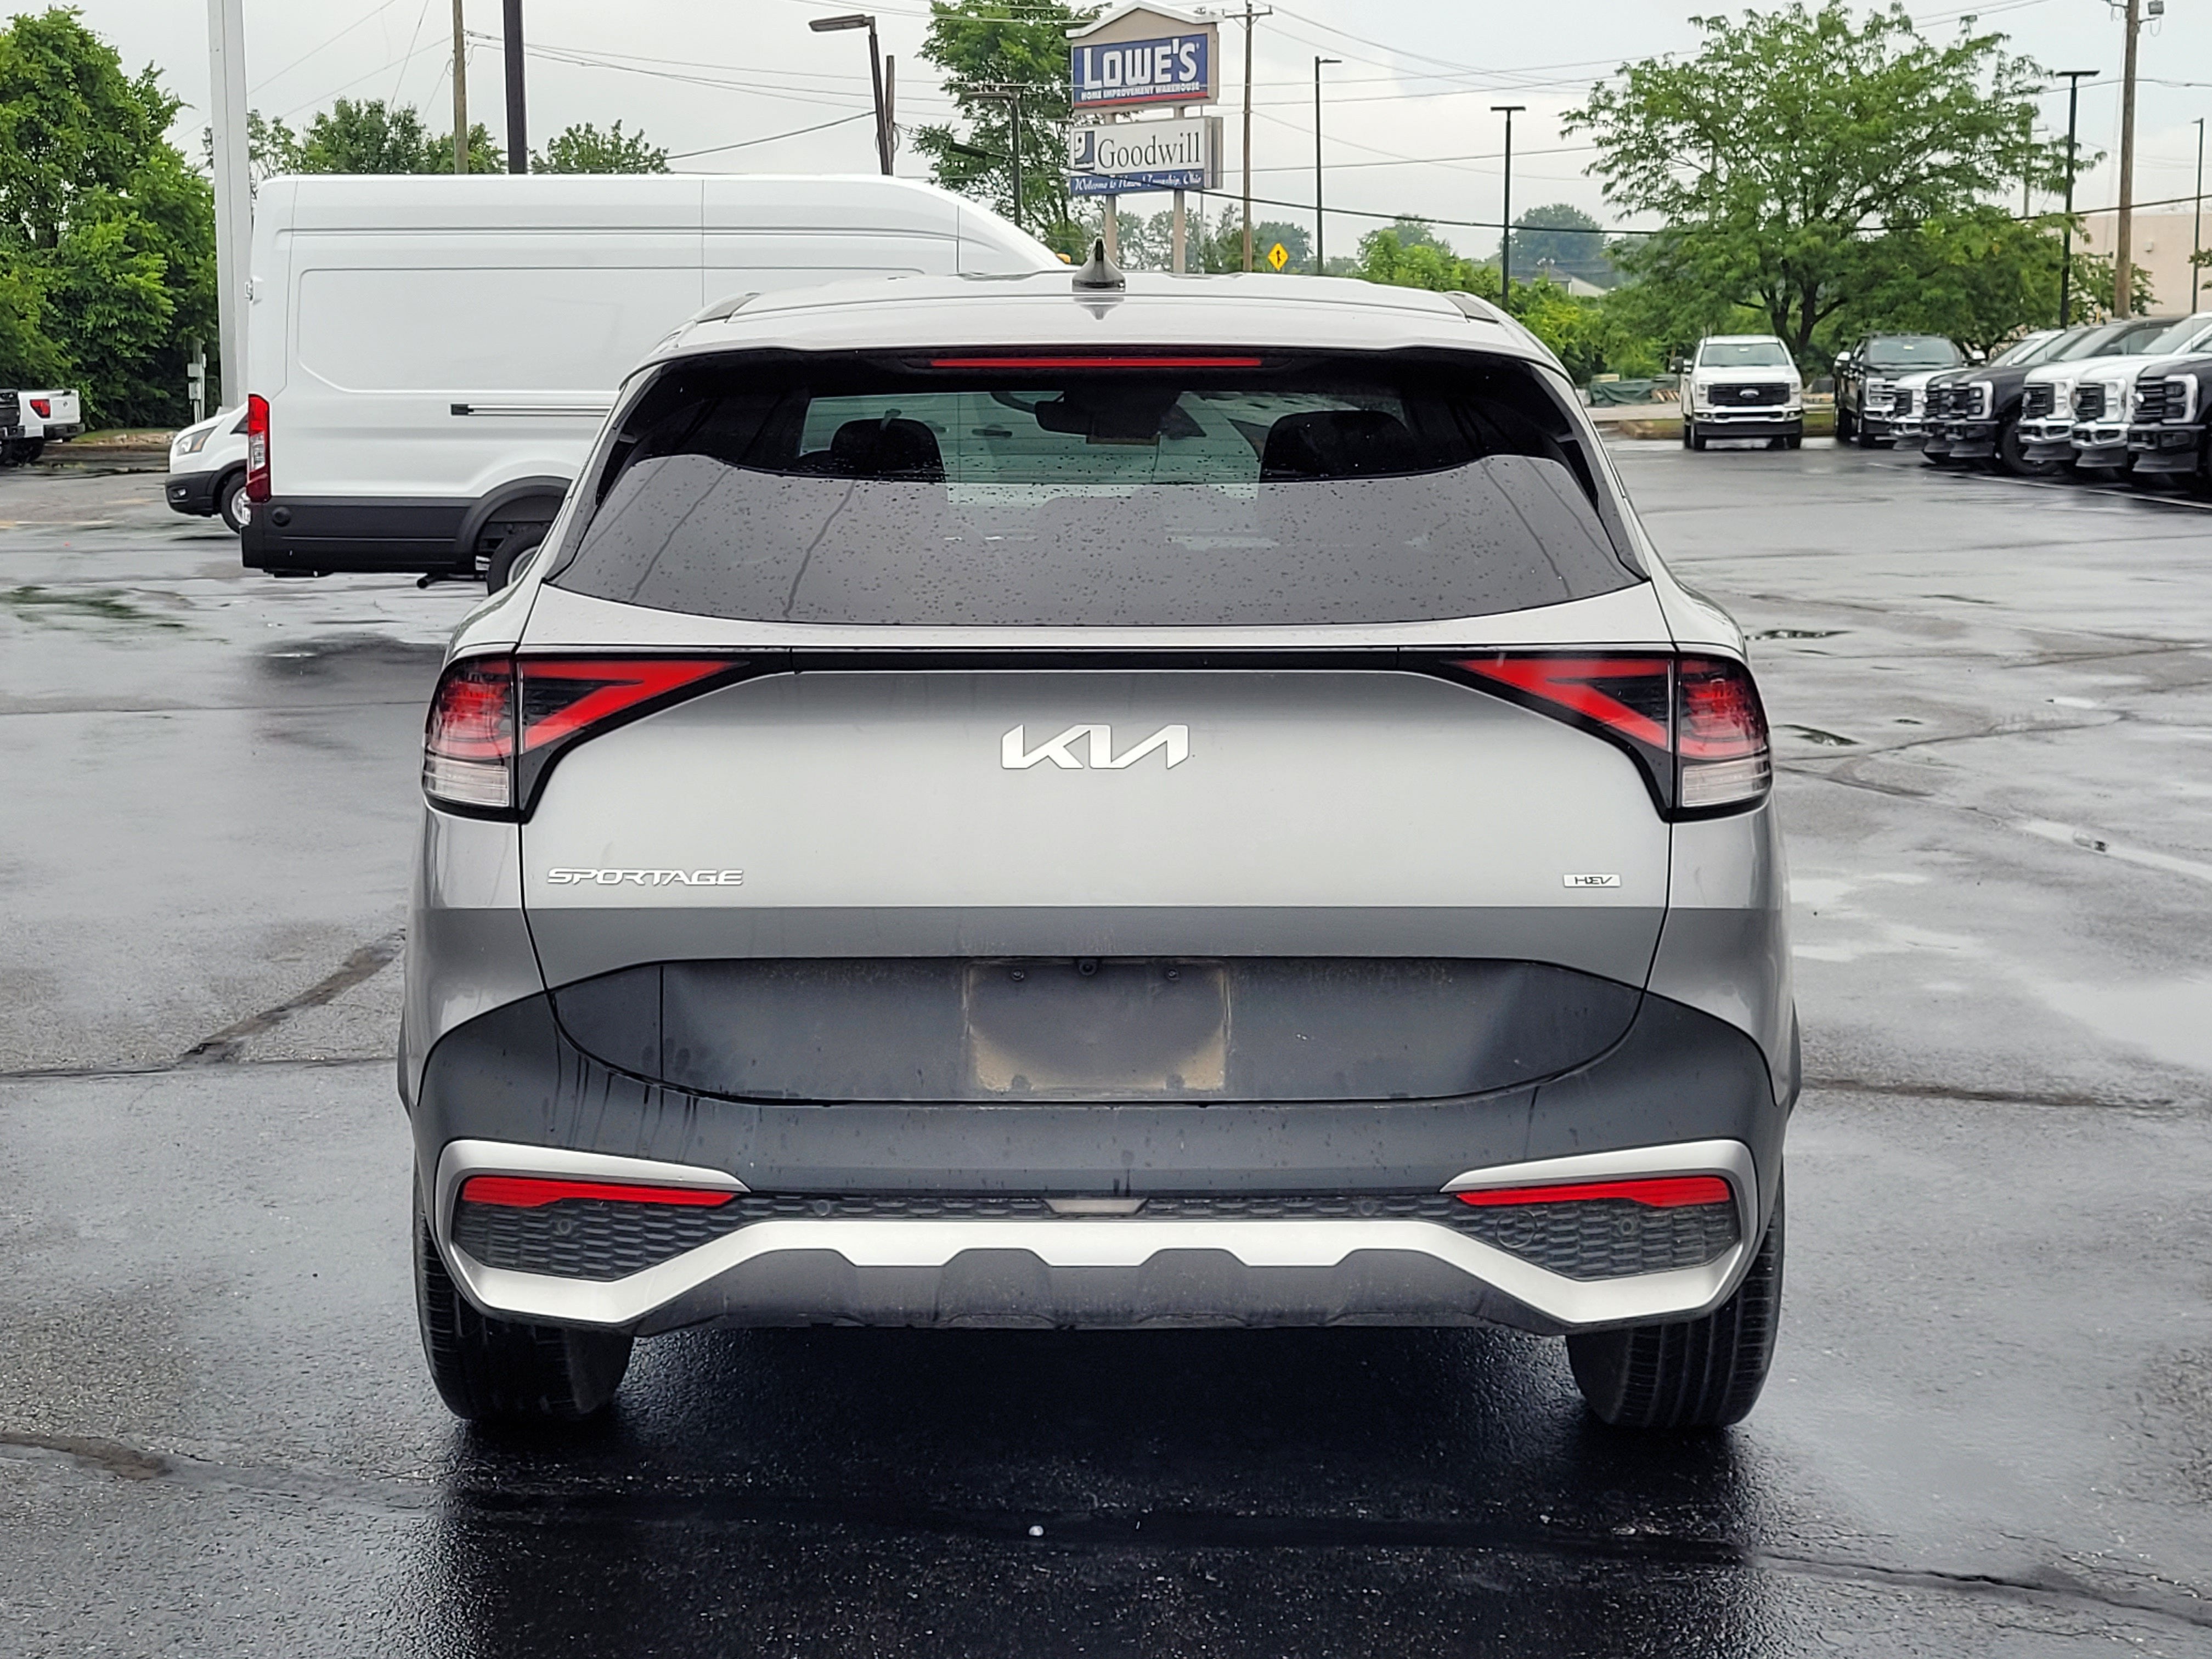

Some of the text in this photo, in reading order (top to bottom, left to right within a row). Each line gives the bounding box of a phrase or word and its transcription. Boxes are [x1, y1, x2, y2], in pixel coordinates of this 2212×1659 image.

[1084, 38, 1198, 90] LOWE'S
[1081, 82, 1200, 101] HOME IMPROVEMENT WAREHOUSE
[1098, 132, 1201, 168] Goodwill
[1001, 724, 1189, 769] KIA
[548, 867, 743, 885] SPORTAGE
[1574, 876, 1613, 885] HEV
